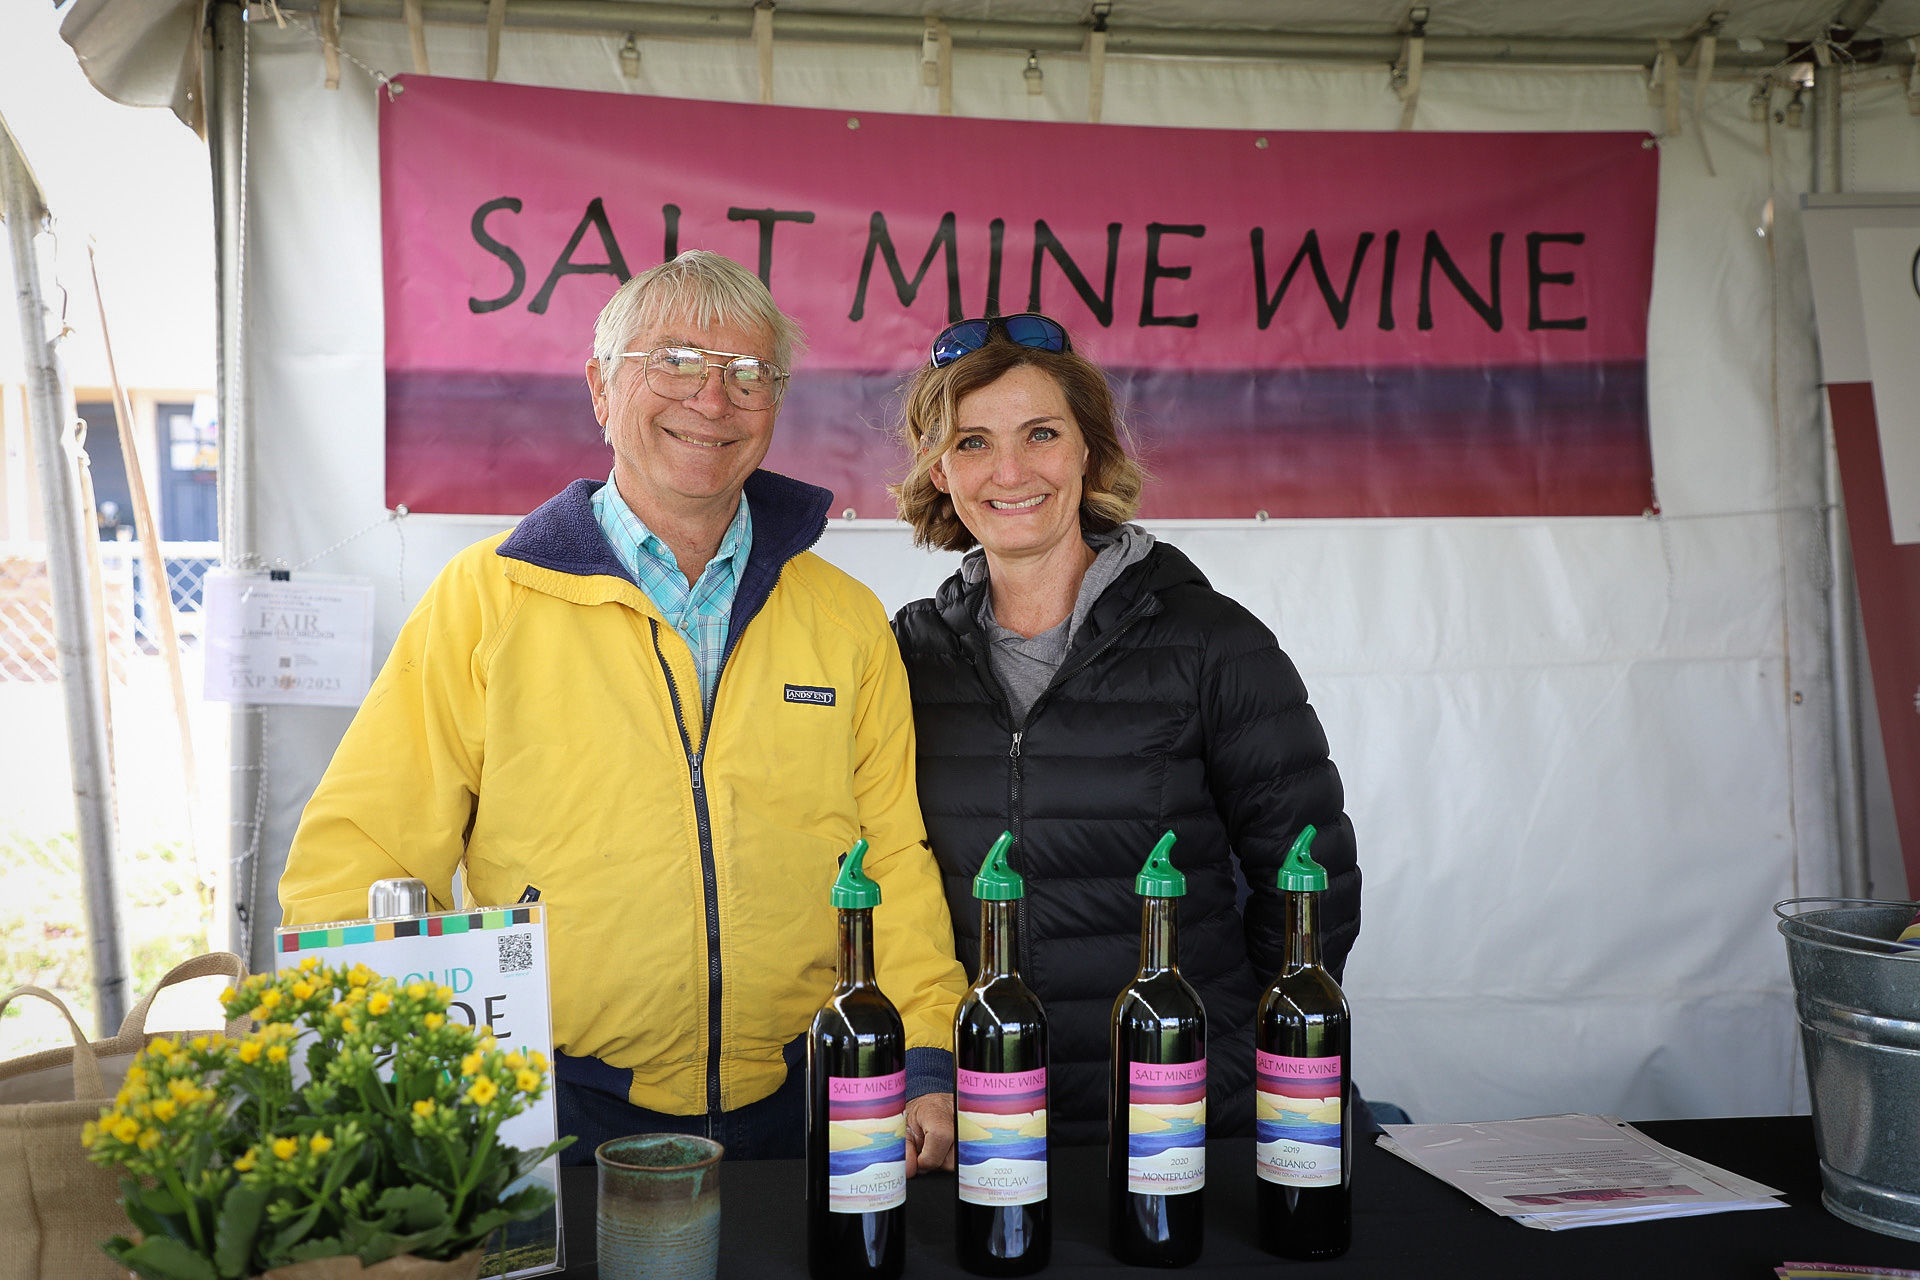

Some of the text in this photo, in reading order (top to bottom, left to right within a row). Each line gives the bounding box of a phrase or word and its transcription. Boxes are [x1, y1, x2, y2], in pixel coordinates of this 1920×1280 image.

[848, 211, 1206, 328] MINE
[1250, 225, 1588, 332] WINE
[1257, 1056, 1337, 1075] SALT MINE WINE
[959, 1072, 1044, 1089] SALT MINE WINE
[1136, 1069, 1162, 1081] SALT
[1165, 1069, 1192, 1081] MINE
[833, 1082, 861, 1095] SALT
[864, 1079, 893, 1093] MINE
[1283, 1145, 1300, 1154] 2019
[1170, 1157, 1189, 1166] 2020
[1270, 1157, 1316, 1169] AGLIANICO
[873, 1171, 891, 1180] 2020
[994, 1167, 1013, 1175] 2020
[977, 1175, 1029, 1187] CATCLAW
